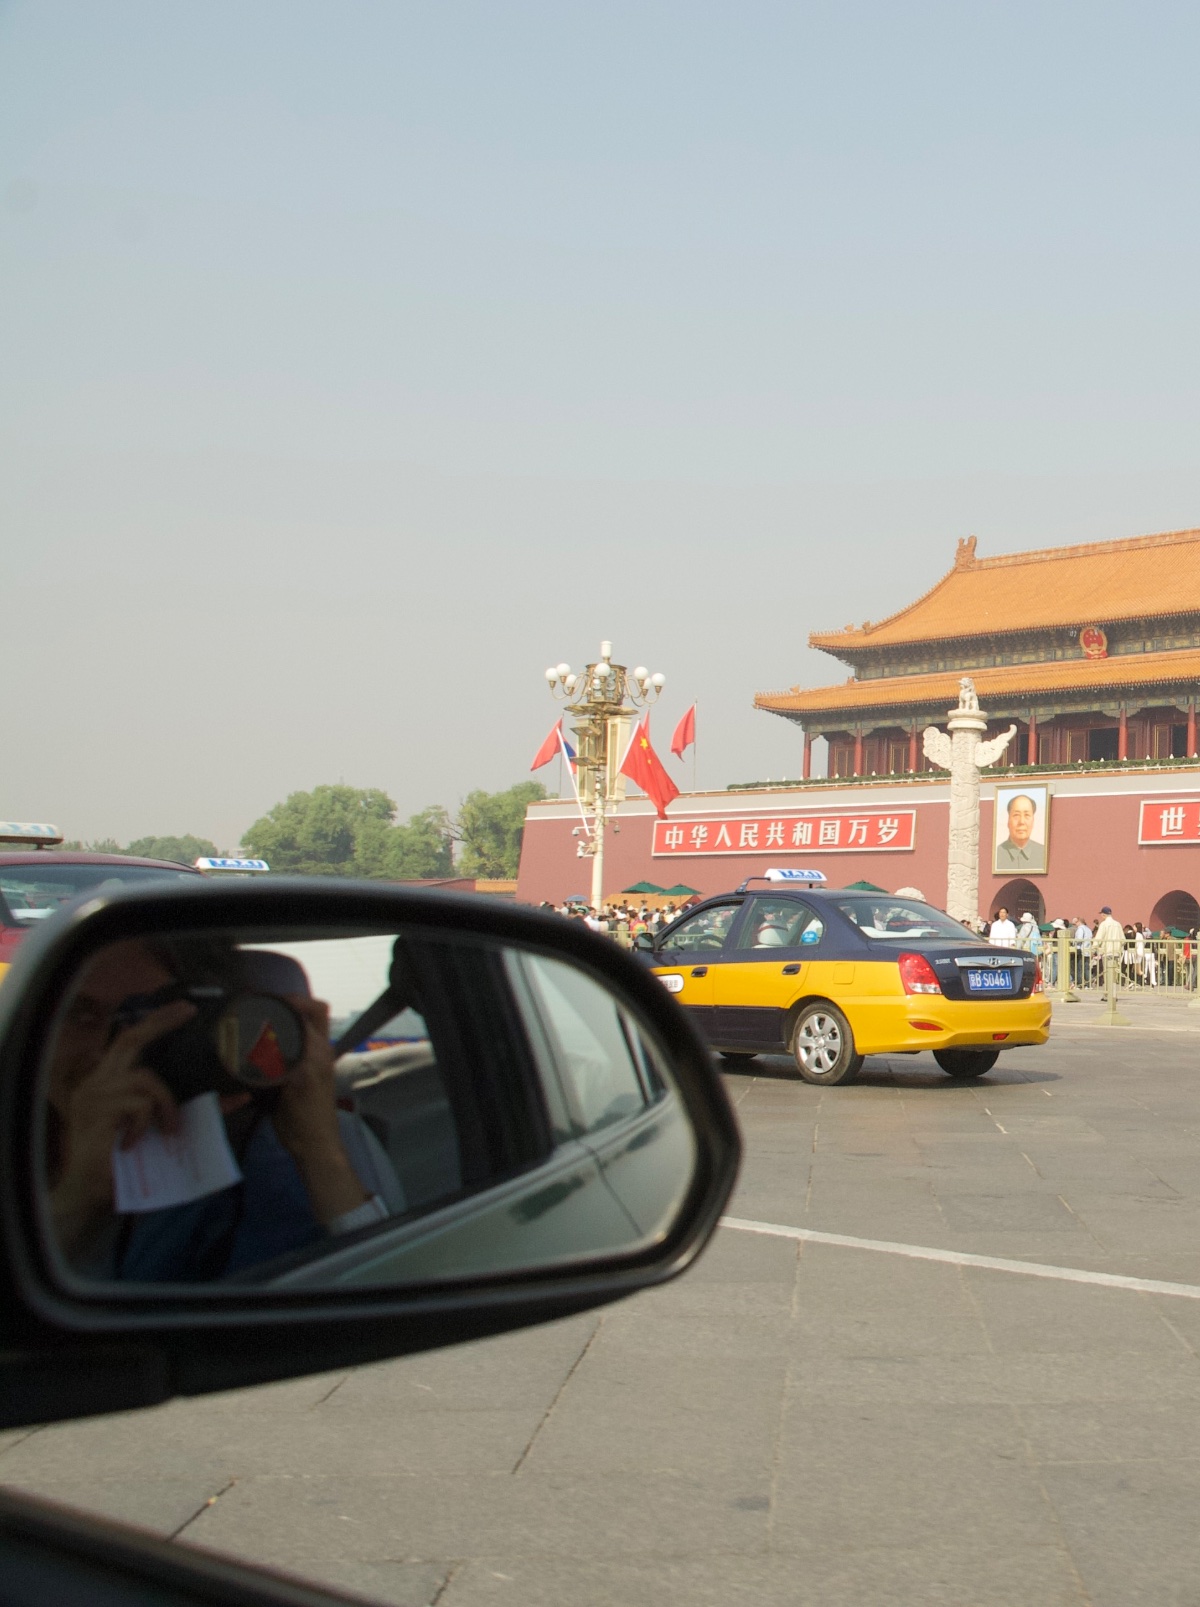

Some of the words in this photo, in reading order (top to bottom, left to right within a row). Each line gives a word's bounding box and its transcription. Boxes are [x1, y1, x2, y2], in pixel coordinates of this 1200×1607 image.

[664, 817, 900, 850] 中华人民共和国万岁
[208, 858, 262, 867] TAXI
[778, 869, 821, 878] TAXI
